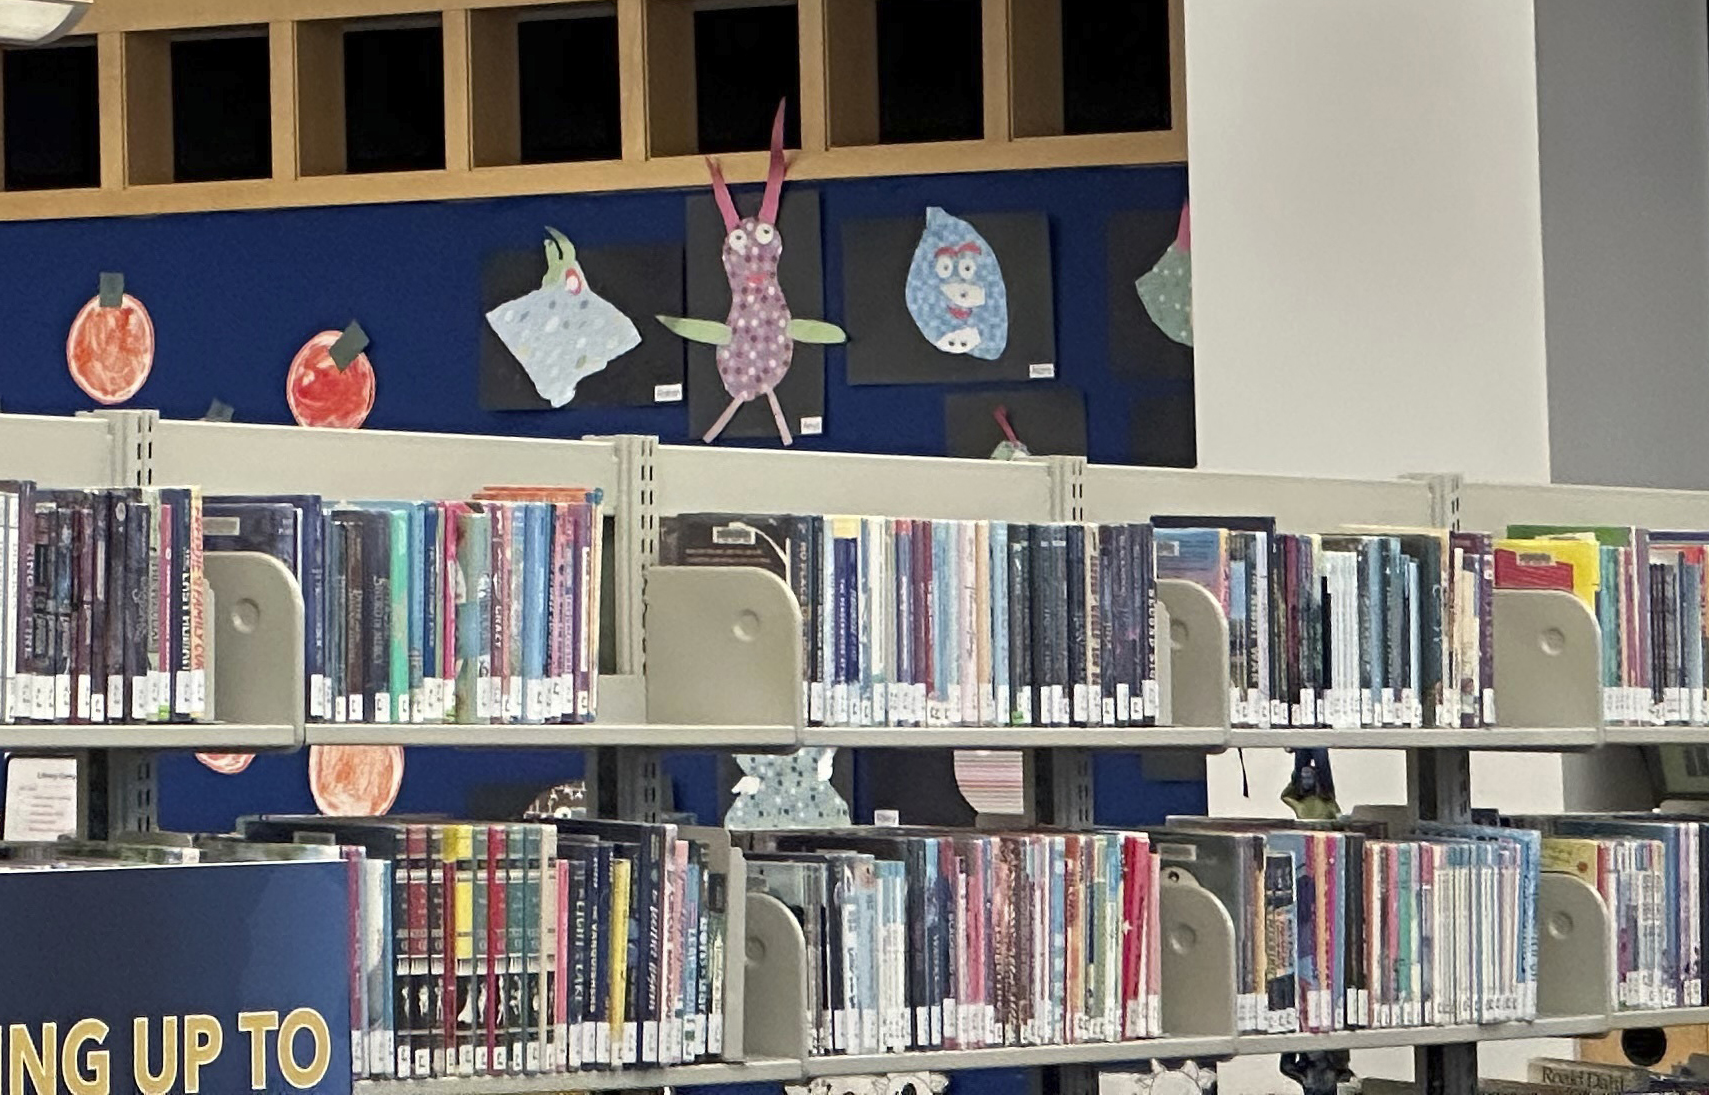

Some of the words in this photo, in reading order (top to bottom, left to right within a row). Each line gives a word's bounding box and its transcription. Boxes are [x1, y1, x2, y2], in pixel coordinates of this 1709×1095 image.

[26, 543, 34, 587] RING
[24, 616, 33, 660] FIRE
[1250, 646, 1259, 684] WAR
[575, 900, 585, 946] LIGHT
[574, 963, 584, 1002] LAKE
[589, 922, 598, 1013] VANQUISHERS
[134, 1014, 223, 1094] UP
[239, 1007, 331, 1091] TO
[1541, 1067, 1583, 1086] Roald
[1589, 1072, 1625, 1093] Dahl
